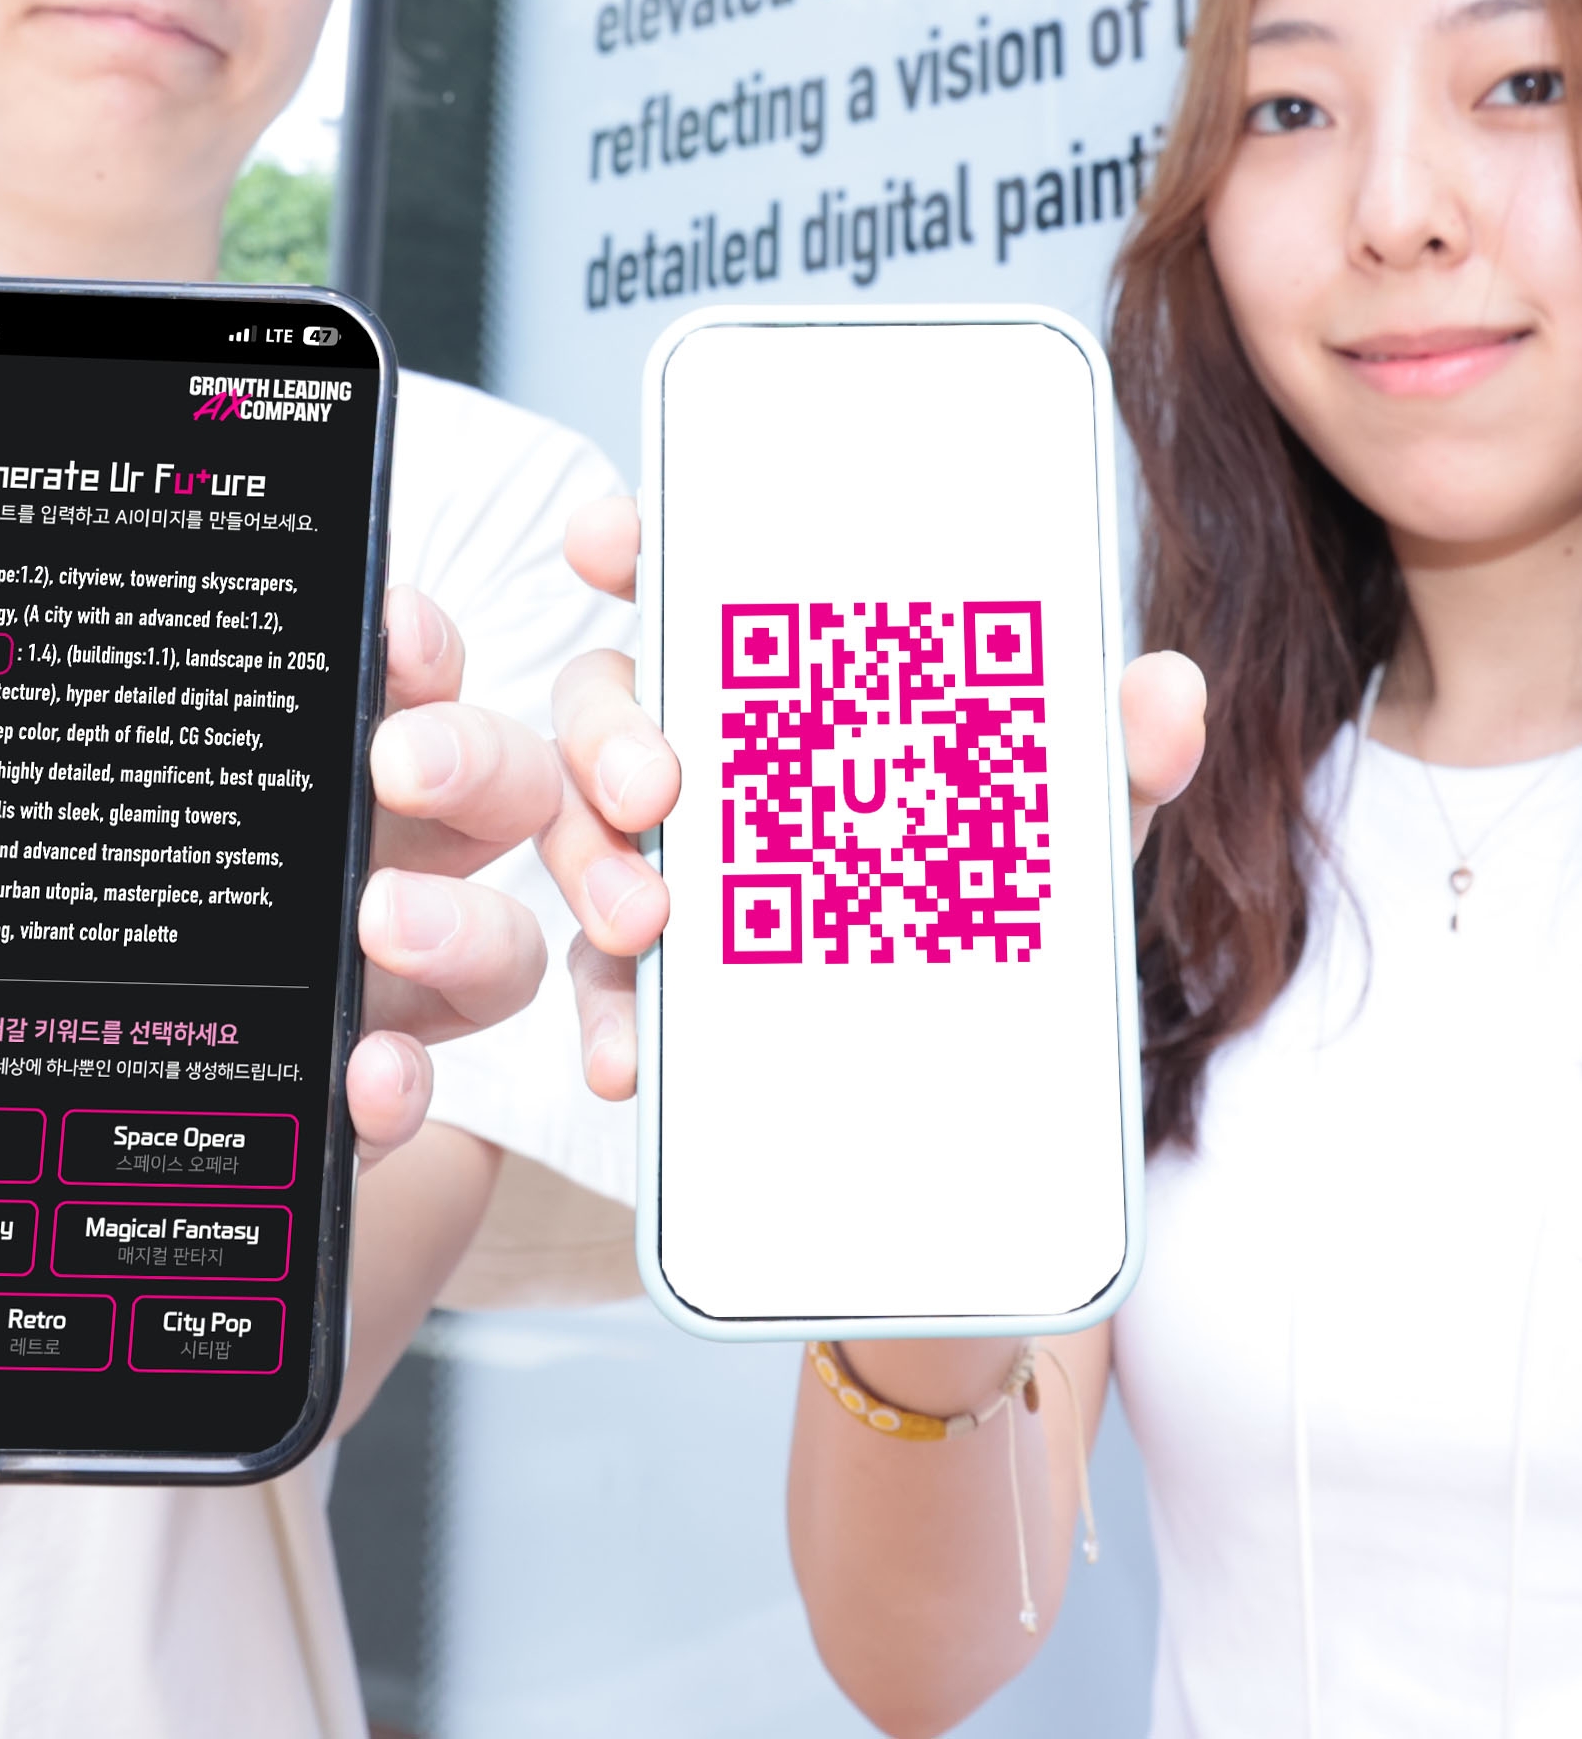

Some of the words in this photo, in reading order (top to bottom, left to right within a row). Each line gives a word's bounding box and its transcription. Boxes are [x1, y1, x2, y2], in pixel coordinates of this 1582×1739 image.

[590, 70, 827, 182] reflecting
[847, 63, 876, 125] a
[895, 15, 1065, 112] vision
[585, 199, 781, 311] detailed
[802, 163, 973, 289] digital
[266, 329, 293, 343] LTE
[309, 329, 332, 343] 47
[189, 375, 269, 400] GROWTH
[273, 379, 352, 401] LEADING
[240, 399, 332, 422] COMPANY
[110, 462, 144, 492] Ur
[41, 505, 110, 525] 입력하고
[115, 508, 203, 529] AI이미지를
[209, 511, 318, 532] 만들어보세요.
[59, 567, 124, 590] cityview,
[130, 570, 196, 593] towering
[202, 572, 297, 596] skyscrapers,
[24, 605, 39, 627] (A
[45, 606, 71, 628] city
[77, 607, 110, 626] with
[115, 612, 133, 625] an
[139, 608, 211, 628] advanced
[216, 610, 283, 635] feel:1.2),
[66, 684, 110, 707] hyper
[115, 685, 176, 705] detailed
[181, 687, 228, 710] digital
[234, 690, 299, 713] painting,
[19, 722, 61, 743] color,
[67, 723, 109, 746] depth
[115, 725, 131, 743] of
[136, 725, 173, 746] field,
[180, 726, 199, 745] CG
[204, 727, 263, 751] Society,
[46, 882, 98, 905] utopia,
[104, 885, 203, 907] masterpiece,
[208, 887, 272, 908] artwork,
[35, 1018, 123, 1044] 키워드를
[130, 1021, 239, 1047] 선택하세요
[47, 1058, 111, 1077] 하나뿐인
[117, 1060, 181, 1079] 이미지를
[186, 1061, 303, 1081] 생성해드립니다.
[114, 1126, 178, 1150] Space
[184, 1127, 245, 1152] Opera
[116, 1154, 183, 1172] 스페이스
[188, 1156, 239, 1174] 오페라
[86, 1217, 166, 1242] Magical
[173, 1219, 259, 1245] Fantasy
[118, 1246, 167, 1265] 매지컬
[173, 1247, 222, 1266] 판타지
[8, 1308, 66, 1329] Retro
[163, 1311, 205, 1337] City
[211, 1312, 251, 1337] Pop
[10, 1338, 60, 1356] 레트로
[181, 1341, 231, 1359] 시티팝
